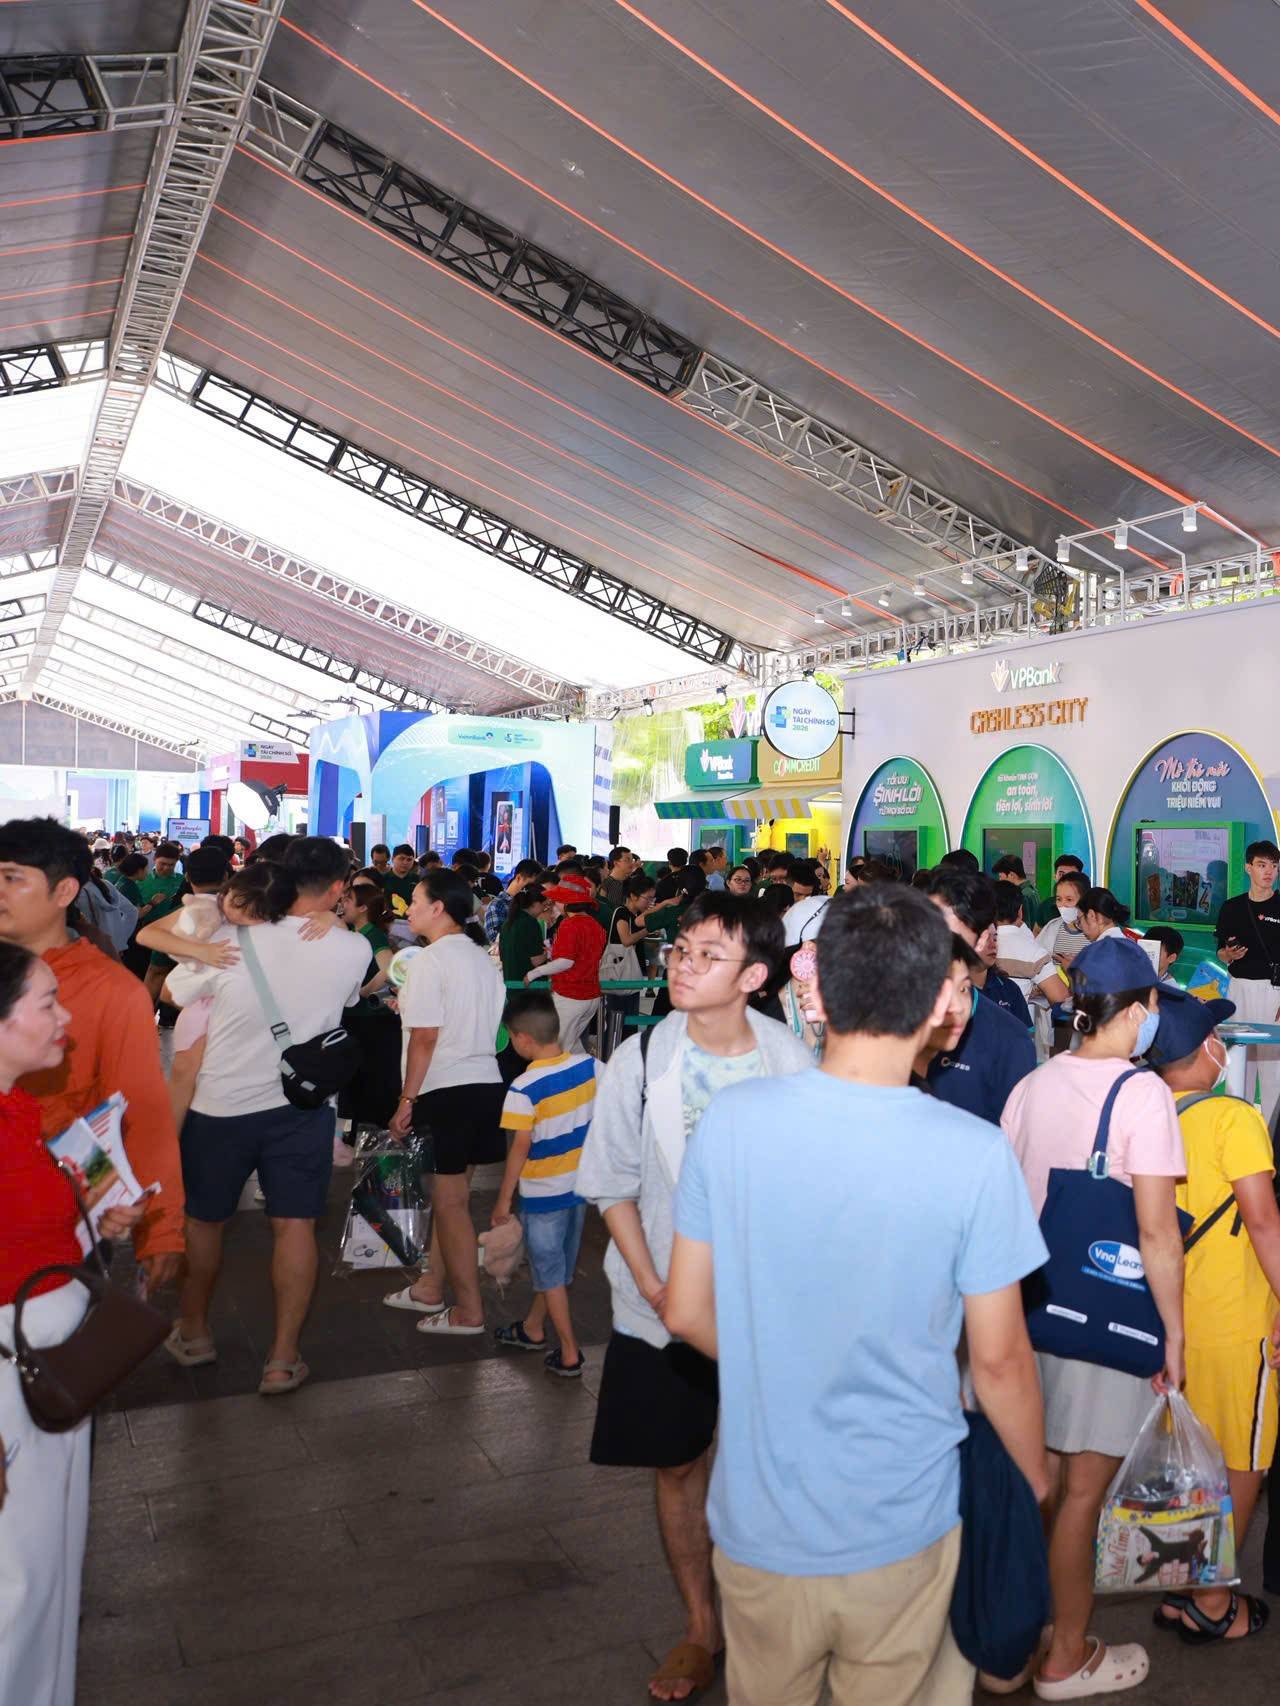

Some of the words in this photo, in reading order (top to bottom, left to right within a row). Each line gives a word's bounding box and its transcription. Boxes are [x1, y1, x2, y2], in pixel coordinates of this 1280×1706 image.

[1010, 662, 1059, 689] VPBank
[793, 706, 811, 715] NGÀY
[970, 702, 1045, 734] CASHLESS
[1048, 696, 1089, 725] CITY
[804, 716, 826, 725] CHÍNH
